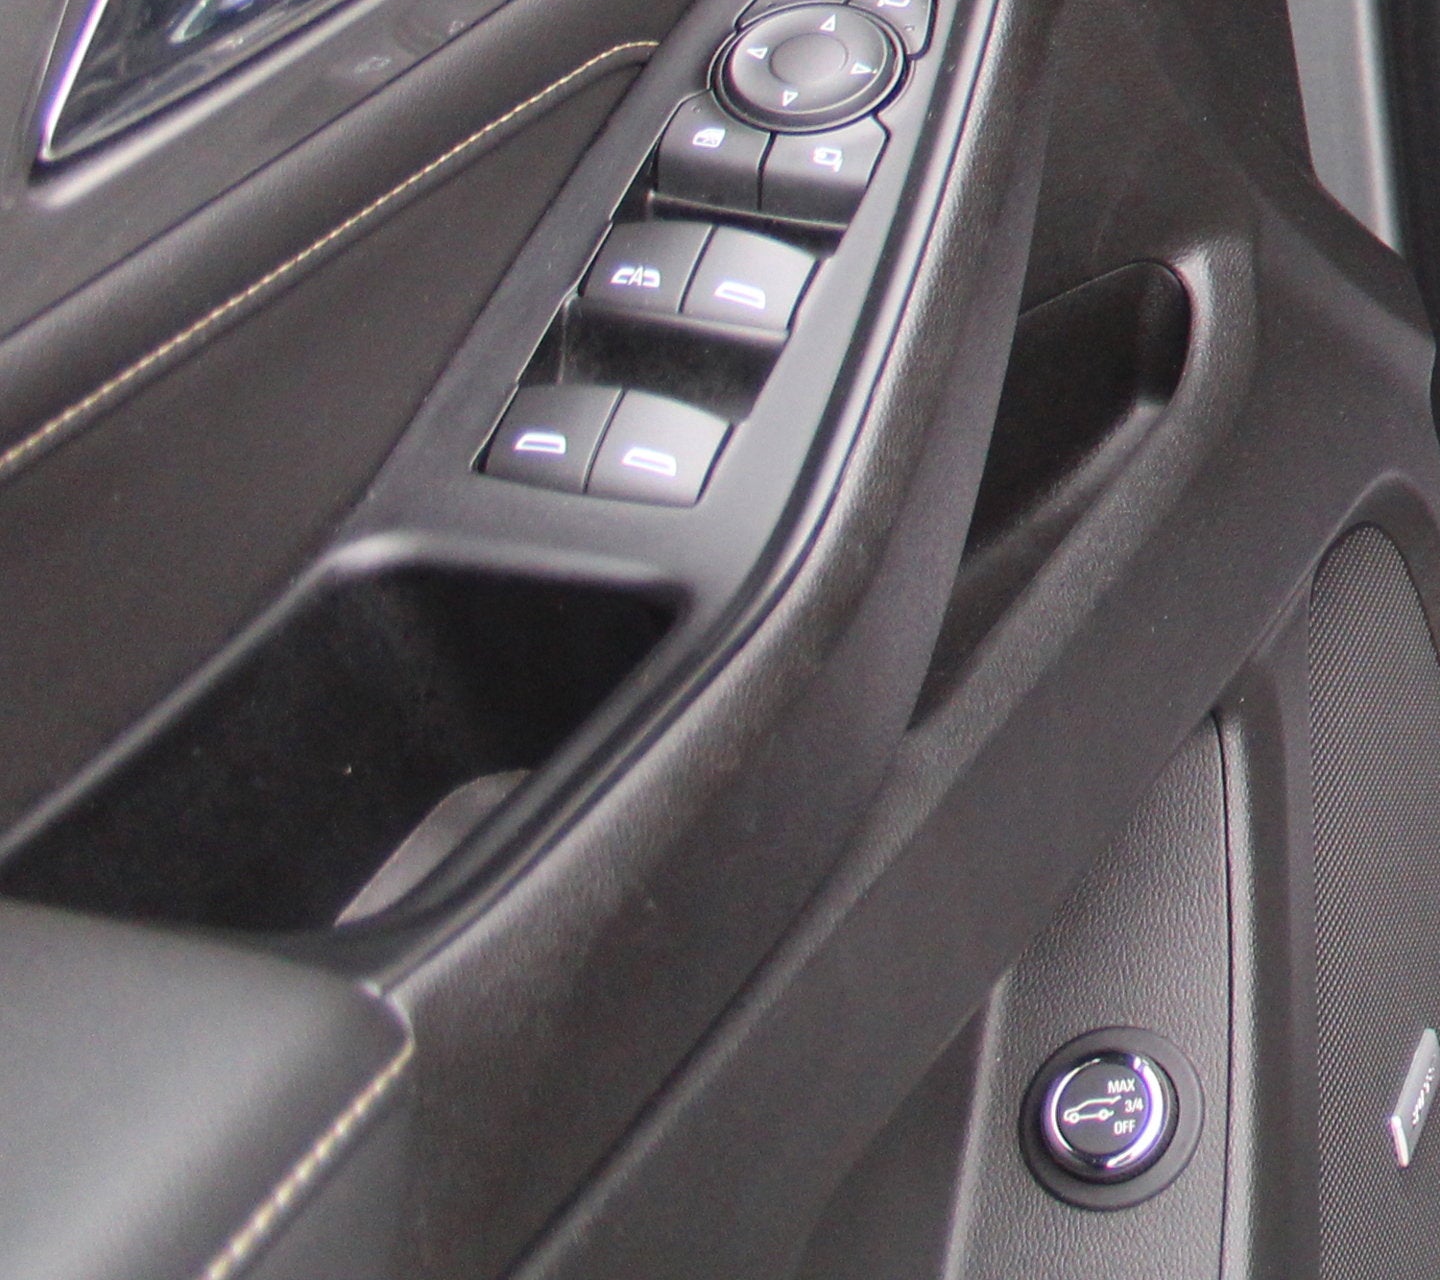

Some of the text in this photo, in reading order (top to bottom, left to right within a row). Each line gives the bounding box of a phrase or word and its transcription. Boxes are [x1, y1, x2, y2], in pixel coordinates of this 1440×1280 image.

[1107, 1079, 1136, 1094] MAX
[1125, 1098, 1144, 1114] 3/4
[1113, 1119, 1136, 1135] OFF
